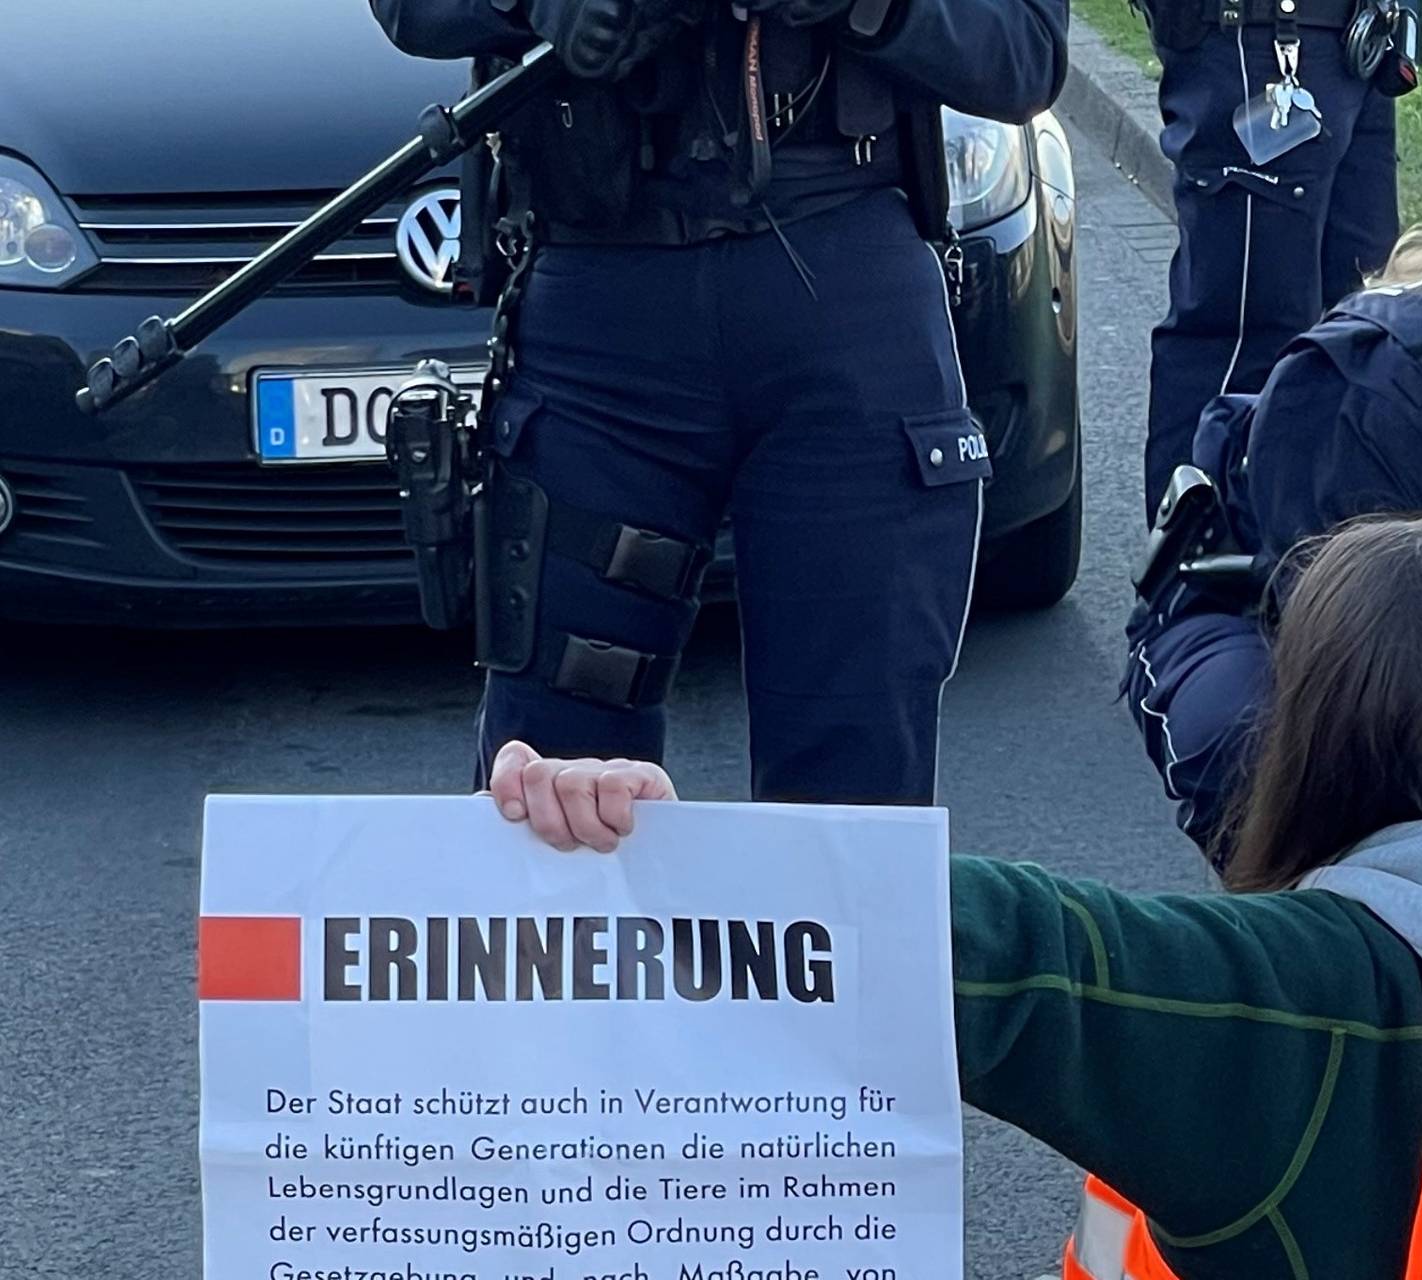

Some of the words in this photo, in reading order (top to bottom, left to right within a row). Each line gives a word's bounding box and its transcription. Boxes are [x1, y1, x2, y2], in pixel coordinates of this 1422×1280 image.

[323, 916, 835, 1004] ERINNERUNG
[266, 1089, 318, 1115] Der
[327, 1089, 403, 1115] Staat
[412, 1088, 511, 1115] schützt
[520, 1087, 588, 1115] auch
[600, 1089, 623, 1114] in
[634, 1088, 847, 1121] Verantwortung
[858, 1086, 896, 1113] für
[265, 1133, 309, 1160] die
[324, 1133, 455, 1167] künftigen
[470, 1136, 666, 1161] Generationen
[681, 1132, 725, 1160] die
[740, 1131, 896, 1159] natürlichen
[268, 1173, 529, 1207] Lebensgrundlagen
[541, 1175, 593, 1205] und
[604, 1175, 648, 1201] die
[658, 1177, 728, 1201] Tiere
[738, 1176, 770, 1199] im
[783, 1173, 896, 1199] Rahmen
[269, 1215, 318, 1242] der
[325, 1216, 616, 1256] verfassungsmäßigen
[627, 1216, 755, 1250] Ordnung
[765, 1213, 843, 1242] durch
[853, 1213, 897, 1241] die
[583, 1262, 649, 1280] ch
